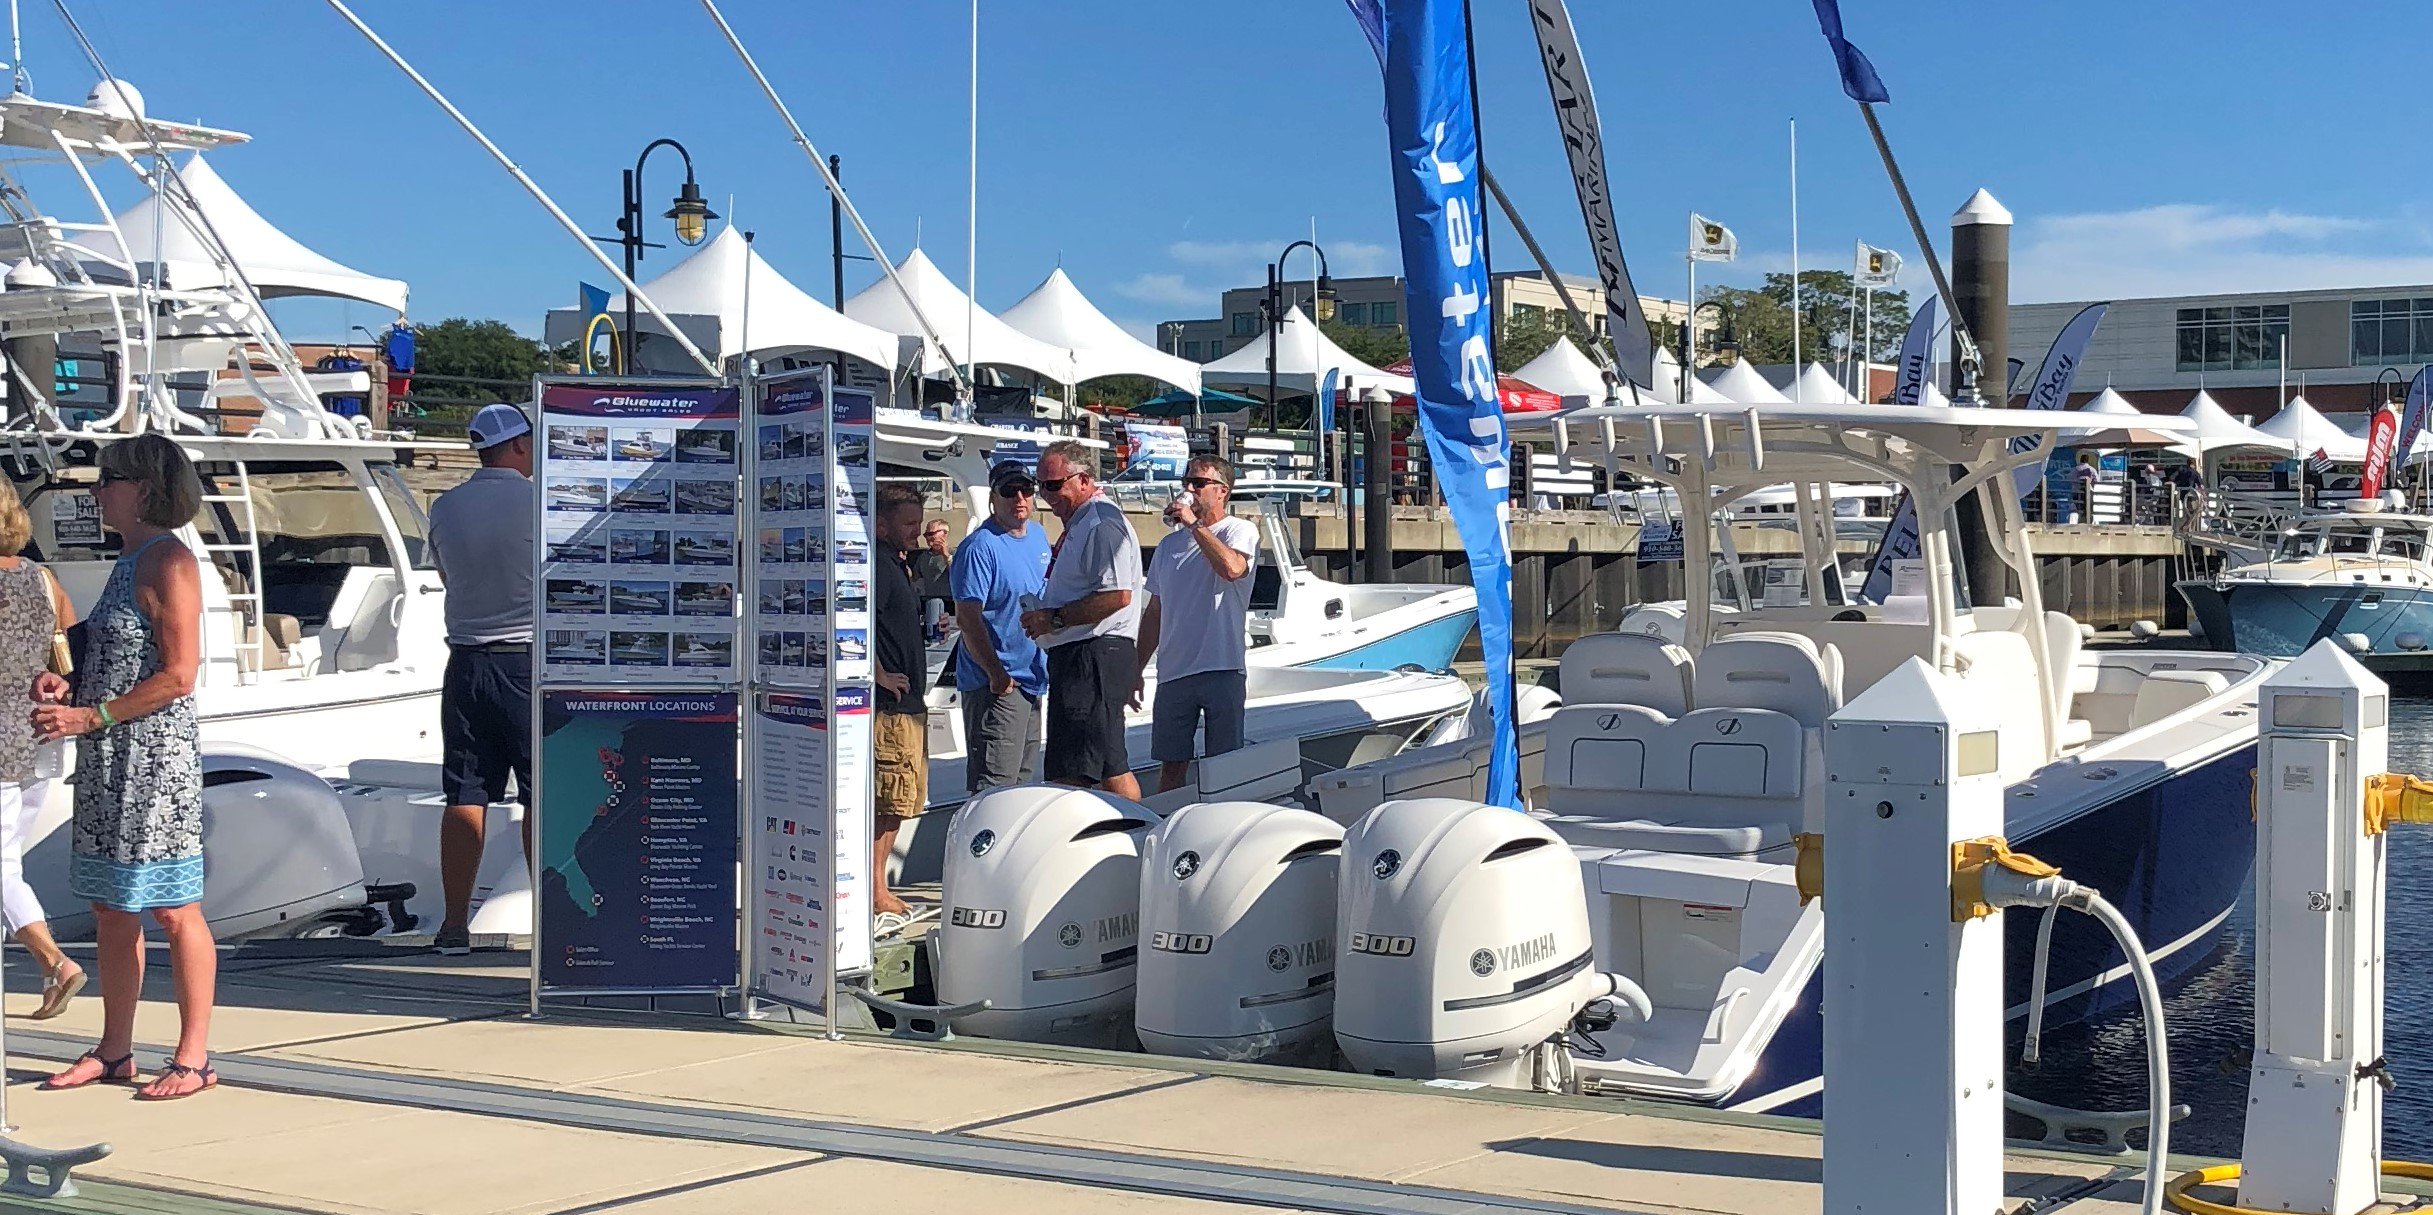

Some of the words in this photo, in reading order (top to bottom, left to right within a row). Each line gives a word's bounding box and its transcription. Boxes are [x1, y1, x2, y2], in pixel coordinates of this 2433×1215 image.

[612, 396, 699, 407] Bluewater
[566, 701, 647, 711] WATERFRONT
[650, 701, 716, 711] LOCATIONS
[952, 906, 1004, 929] 300
[1152, 931, 1212, 953] 300
[1351, 933, 1415, 956] 300
[1497, 932, 1557, 972] YAMAHA
